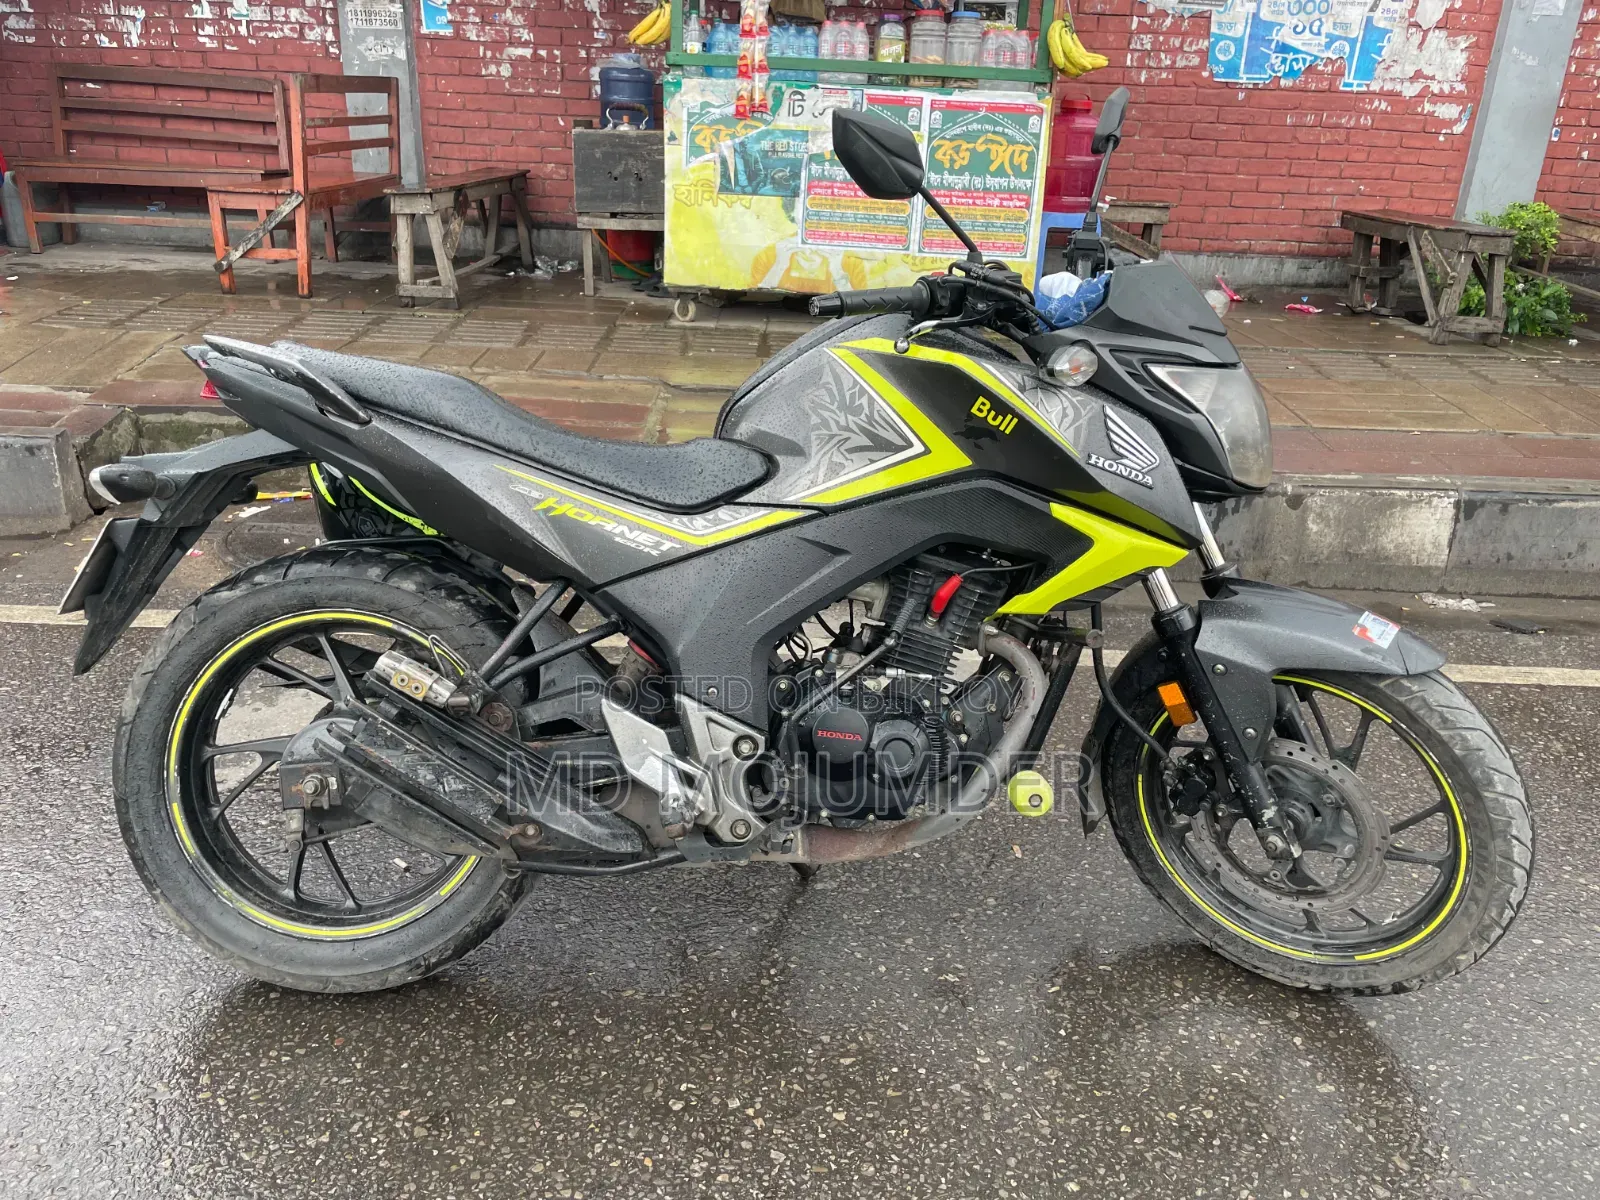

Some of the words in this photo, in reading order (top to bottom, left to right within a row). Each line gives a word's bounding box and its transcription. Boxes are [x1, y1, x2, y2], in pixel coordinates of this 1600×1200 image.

[346, 9, 398, 18] 1811996325
[971, 395, 1019, 435] Bull
[1087, 452, 1155, 489] HONDA
[532, 497, 683, 552] HORNET
[817, 729, 863, 741] HONDA
